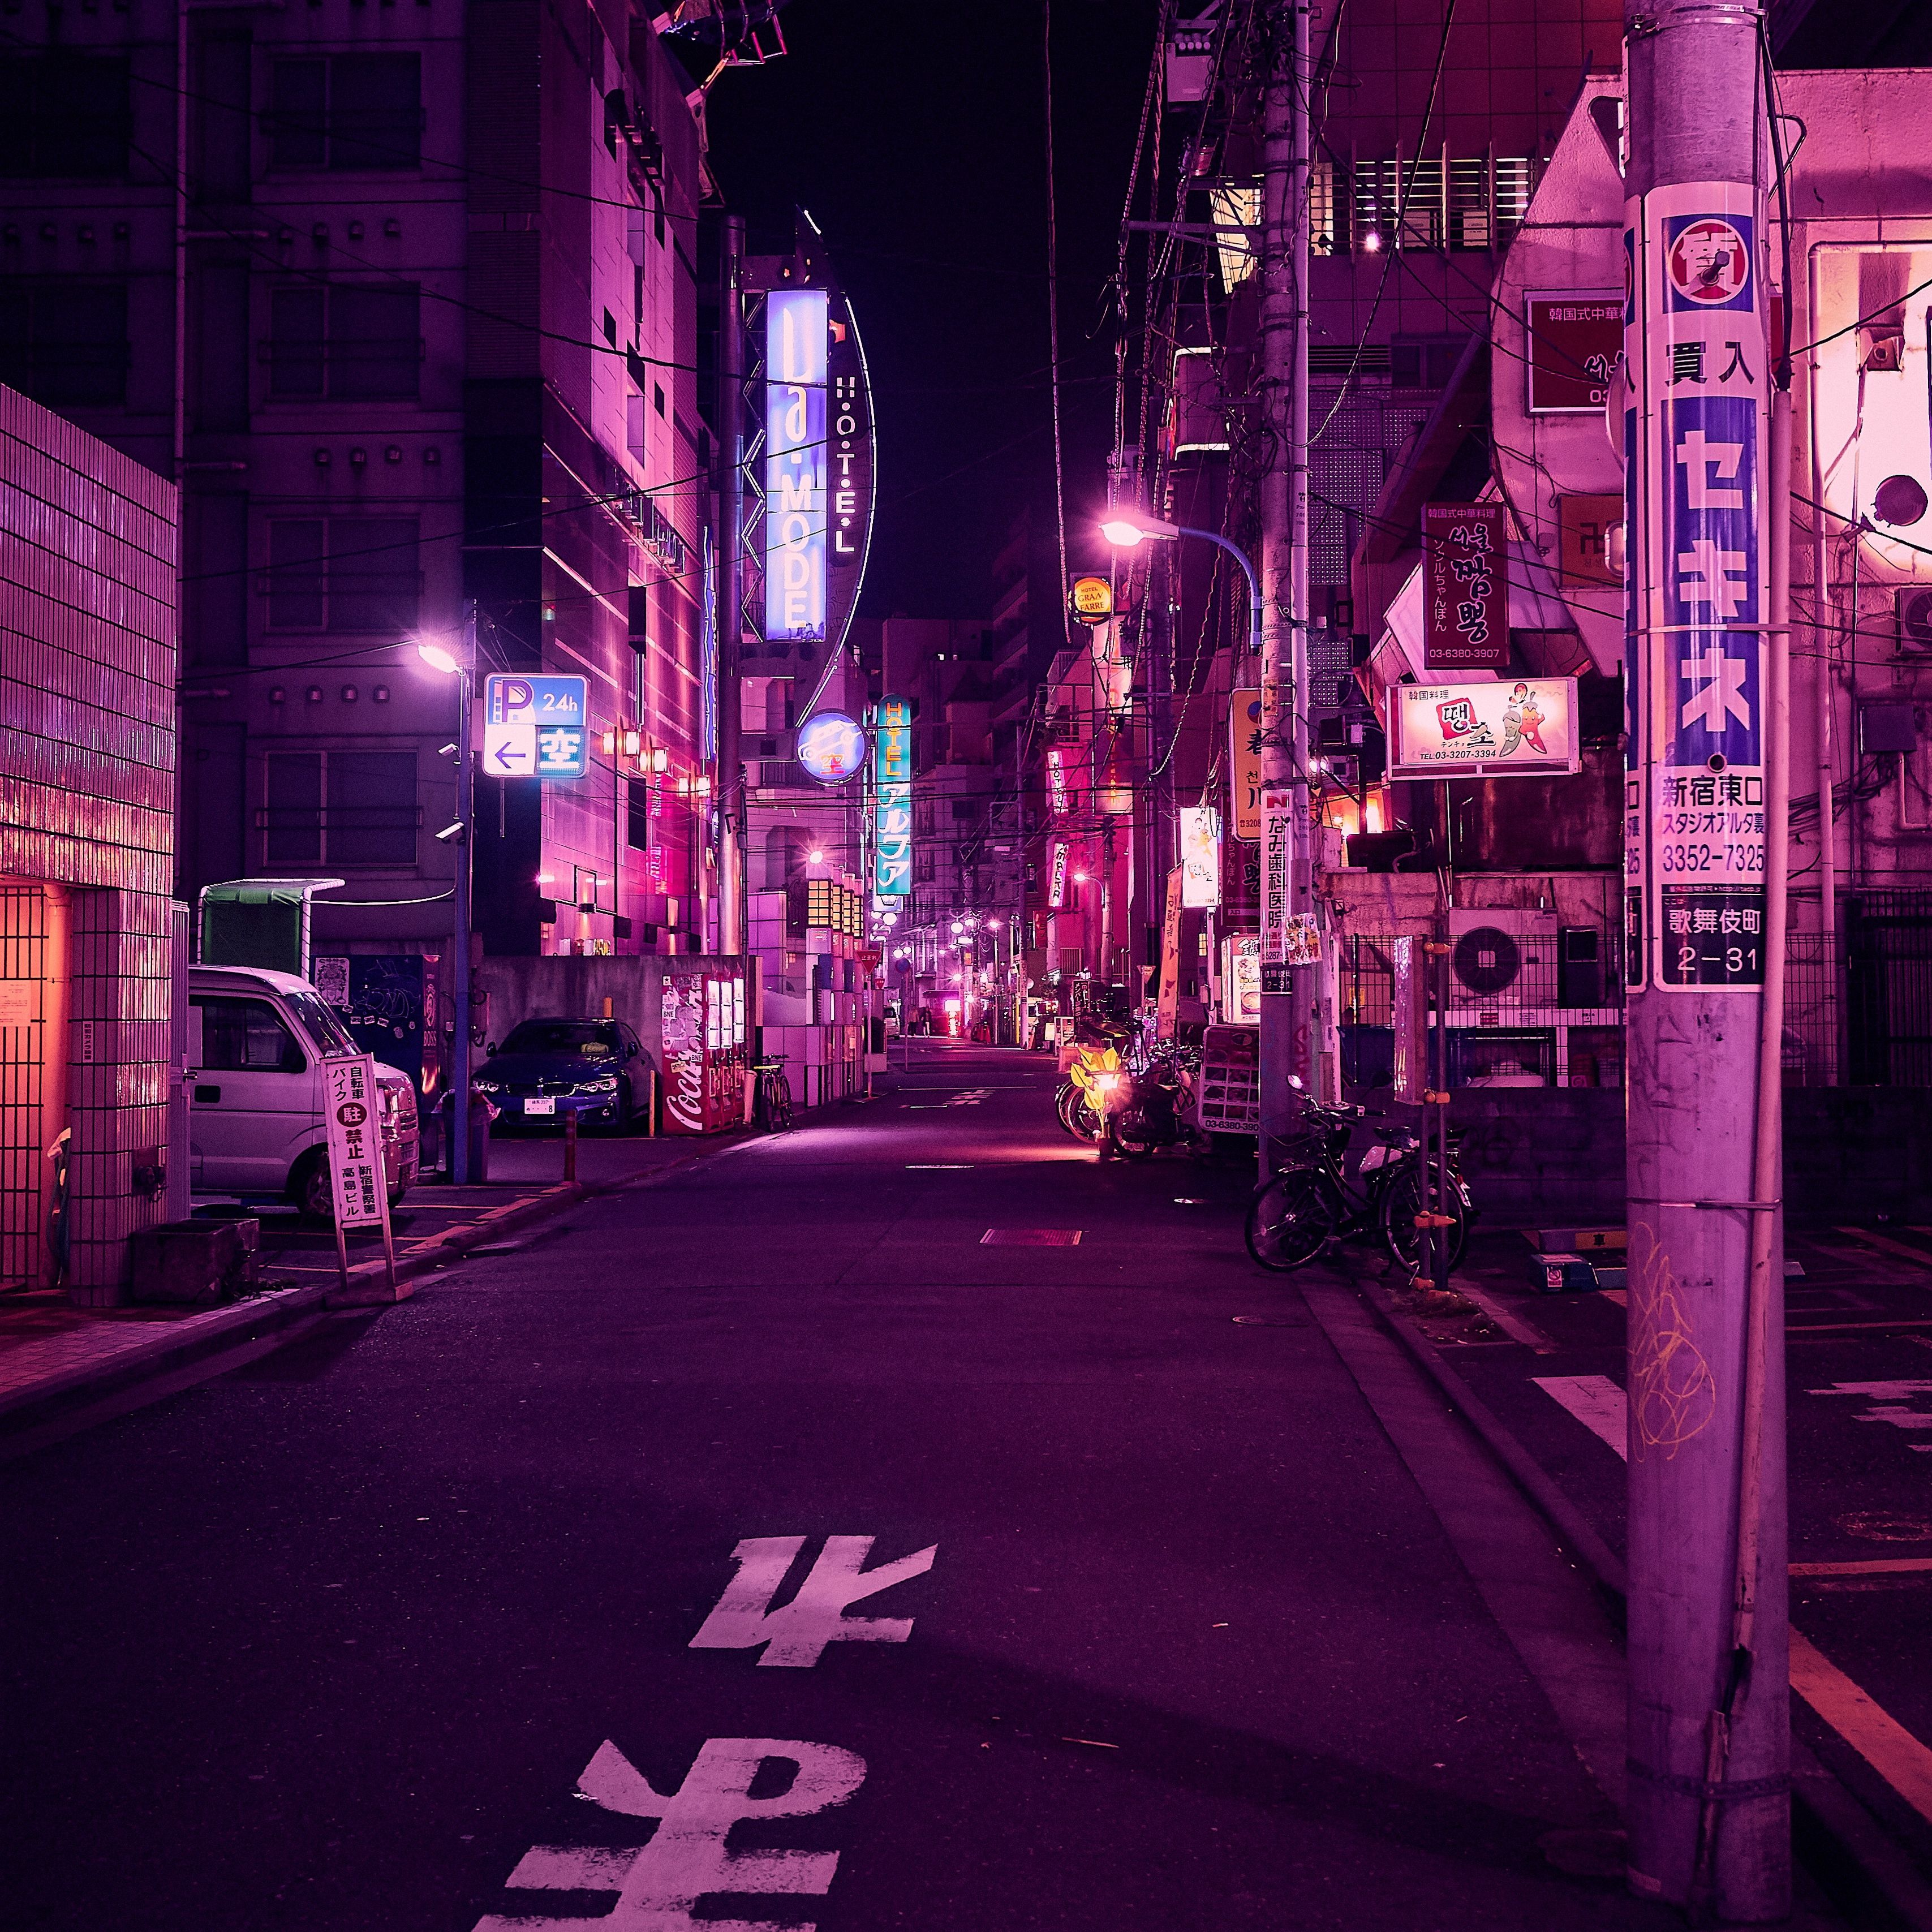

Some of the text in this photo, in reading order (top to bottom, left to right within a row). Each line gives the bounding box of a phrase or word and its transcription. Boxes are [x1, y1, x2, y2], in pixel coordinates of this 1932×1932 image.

[1666, 342, 1754, 385] 買入
[1427, 509, 1496, 518] 韓国式中華料理
[1676, 430, 1750, 732] セキネ
[1078, 592, 1103, 602] GRAN
[1429, 649, 1499, 659] 03-6380-3907
[542, 693, 578, 712] 24h
[1409, 690, 1449, 700] 韓国料理
[539, 728, 581, 769] 空
[886, 702, 902, 776] HOTEL
[1663, 776, 1763, 807] 新宿東口
[1663, 812, 1764, 836] スタジオアルタ裏
[1663, 844, 1764, 873] 3352-7325
[1669, 909, 1760, 935] 歌舞伎町
[1678, 946, 1757, 972] 2-31
[332, 1067, 348, 1102] バイク
[350, 1066, 365, 1100] 自転車
[345, 1129, 365, 1160] 禁止
[342, 1167, 359, 1217] 高島ビル
[359, 1165, 376, 1215] 新宿警察署
